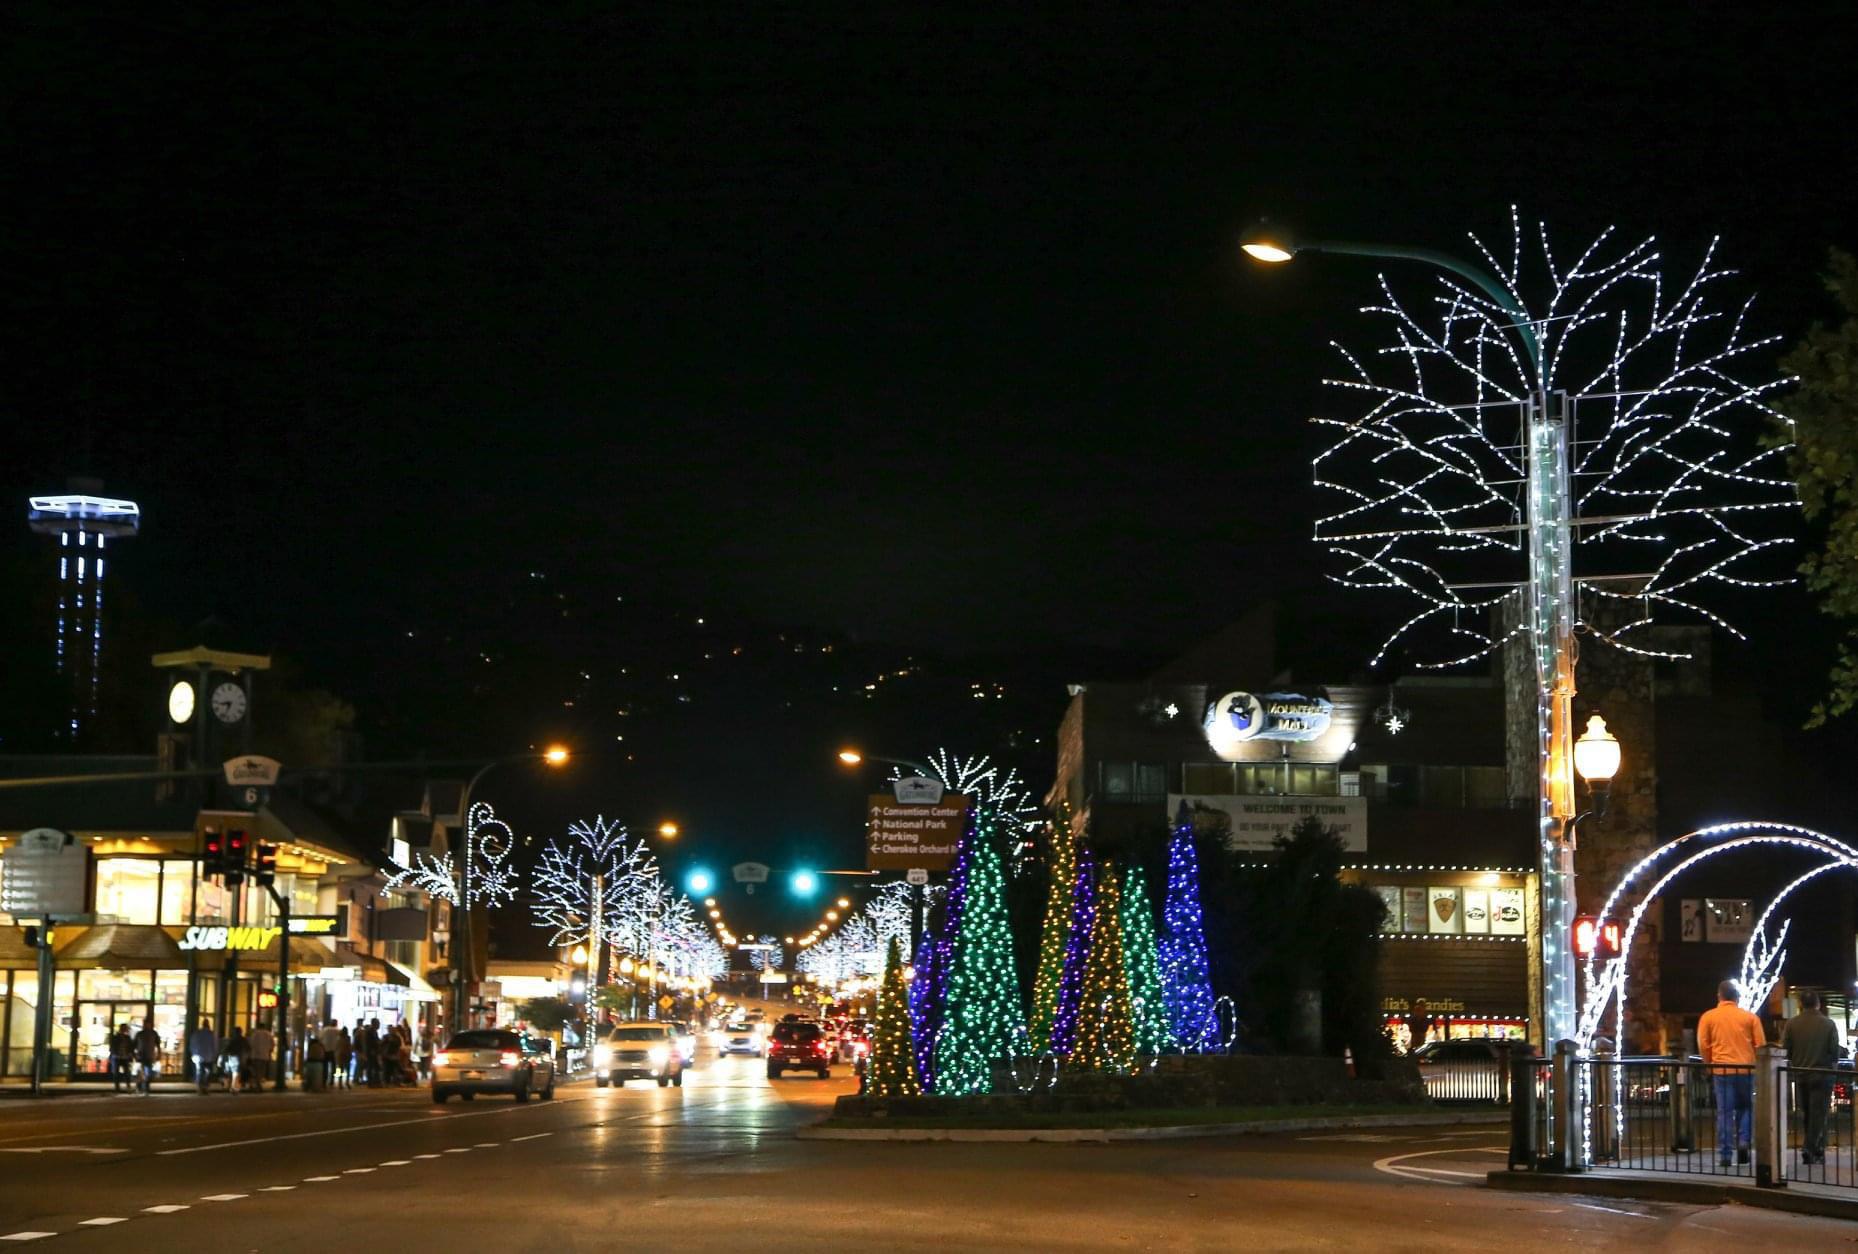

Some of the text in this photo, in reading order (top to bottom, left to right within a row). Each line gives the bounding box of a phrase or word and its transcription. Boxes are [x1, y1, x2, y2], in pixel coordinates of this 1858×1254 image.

[1279, 719, 1310, 731] MALL
[245, 788, 257, 803] 6
[882, 807, 959, 817] Convention Center
[1243, 804, 1346, 815] WELCOME TO TOWN
[882, 820, 947, 829] National Park
[882, 832, 919, 843] Parking
[882, 844, 918, 853] Cherokee
[919, 844, 949, 853] Orchard
[746, 884, 755, 895] 6
[178, 926, 283, 950] SUBWAY
[1415, 997, 1465, 1011] Candies
